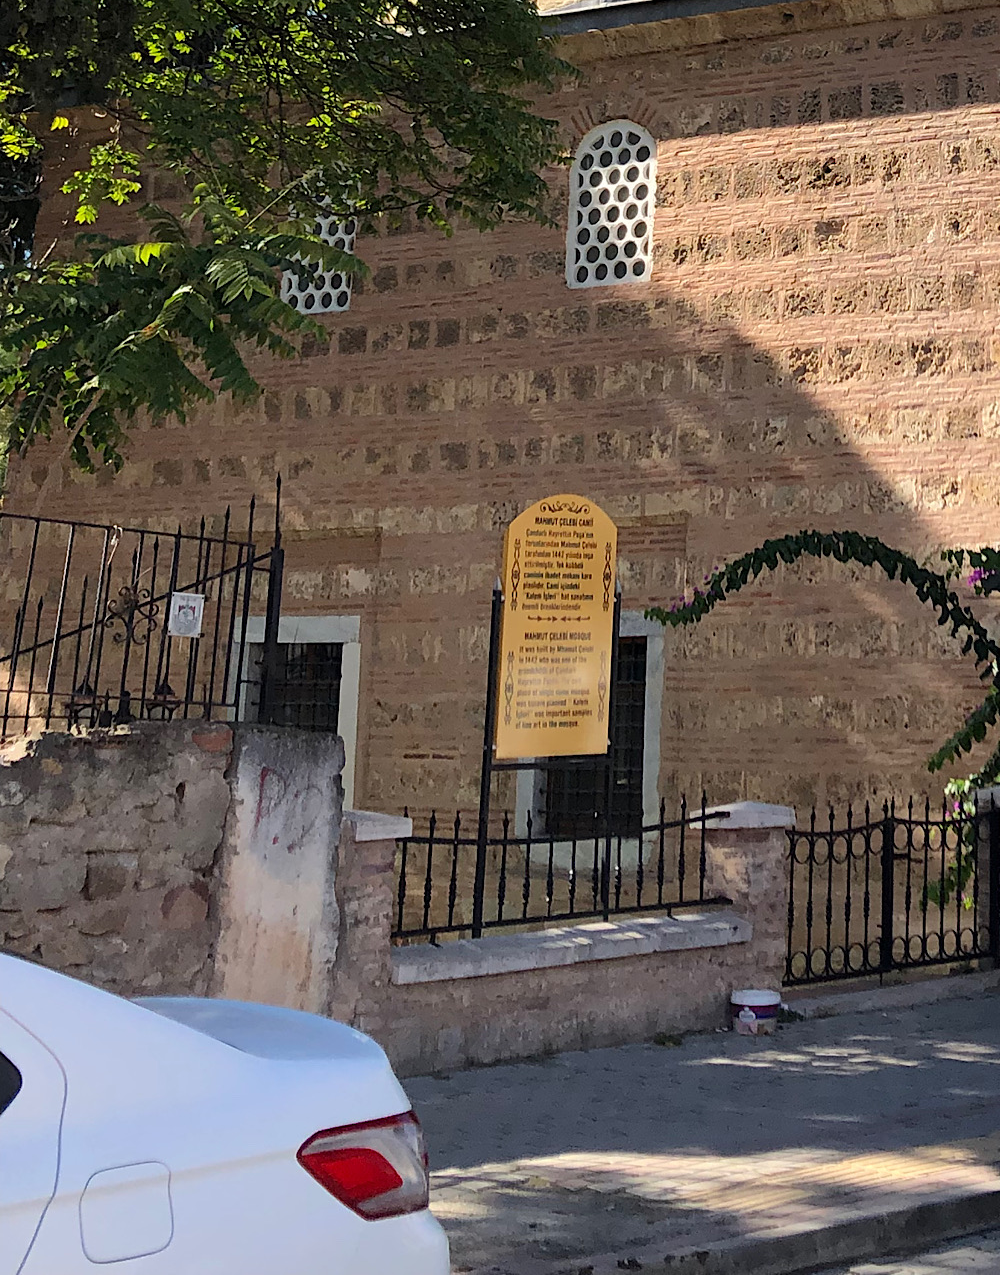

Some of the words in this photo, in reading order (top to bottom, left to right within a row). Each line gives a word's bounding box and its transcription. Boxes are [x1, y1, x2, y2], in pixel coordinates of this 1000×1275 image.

[535, 517, 558, 526] MAHMUT
[559, 517, 578, 528] ÇELEBİ
[552, 550, 564, 558] 1442
[524, 632, 548, 640] MAHMUT
[569, 632, 591, 641] MOSQUE
[550, 646, 555, 654] by
